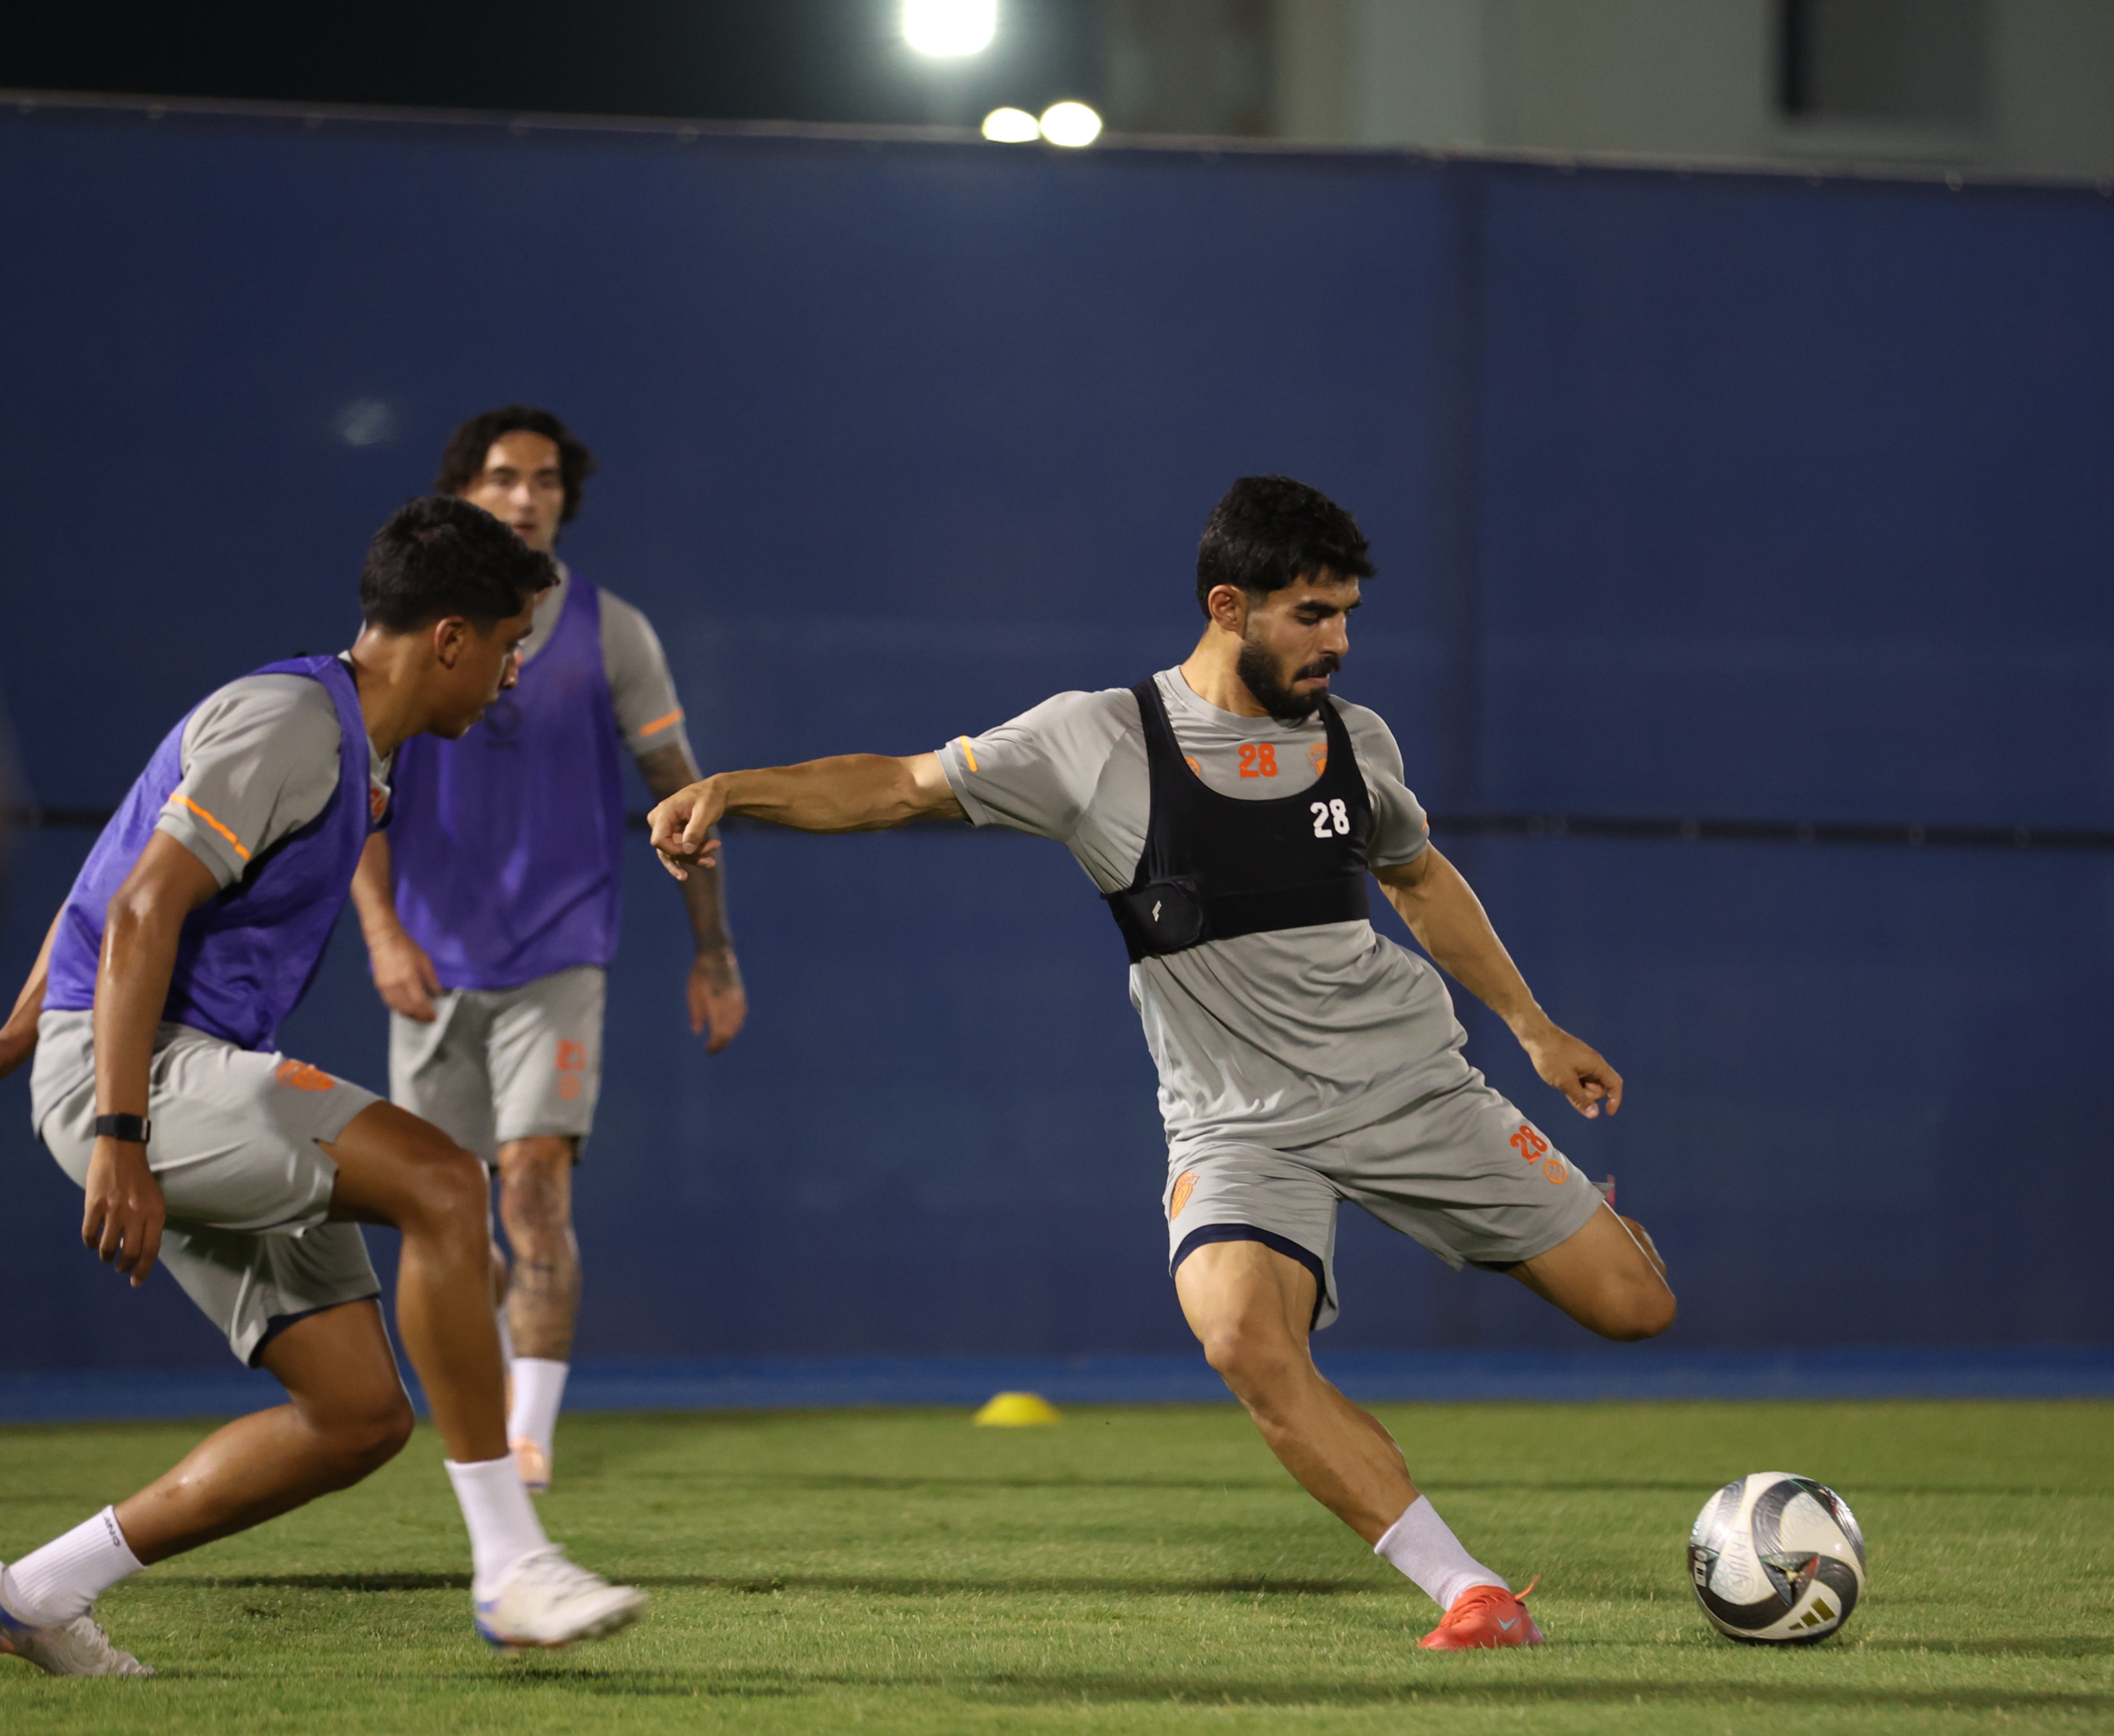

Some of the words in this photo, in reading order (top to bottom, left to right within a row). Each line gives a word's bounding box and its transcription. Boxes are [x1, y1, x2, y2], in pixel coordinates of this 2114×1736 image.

[1238, 744, 1278, 778] 28
[1310, 798, 1351, 838] 28
[1510, 1125, 1548, 1165] 28
